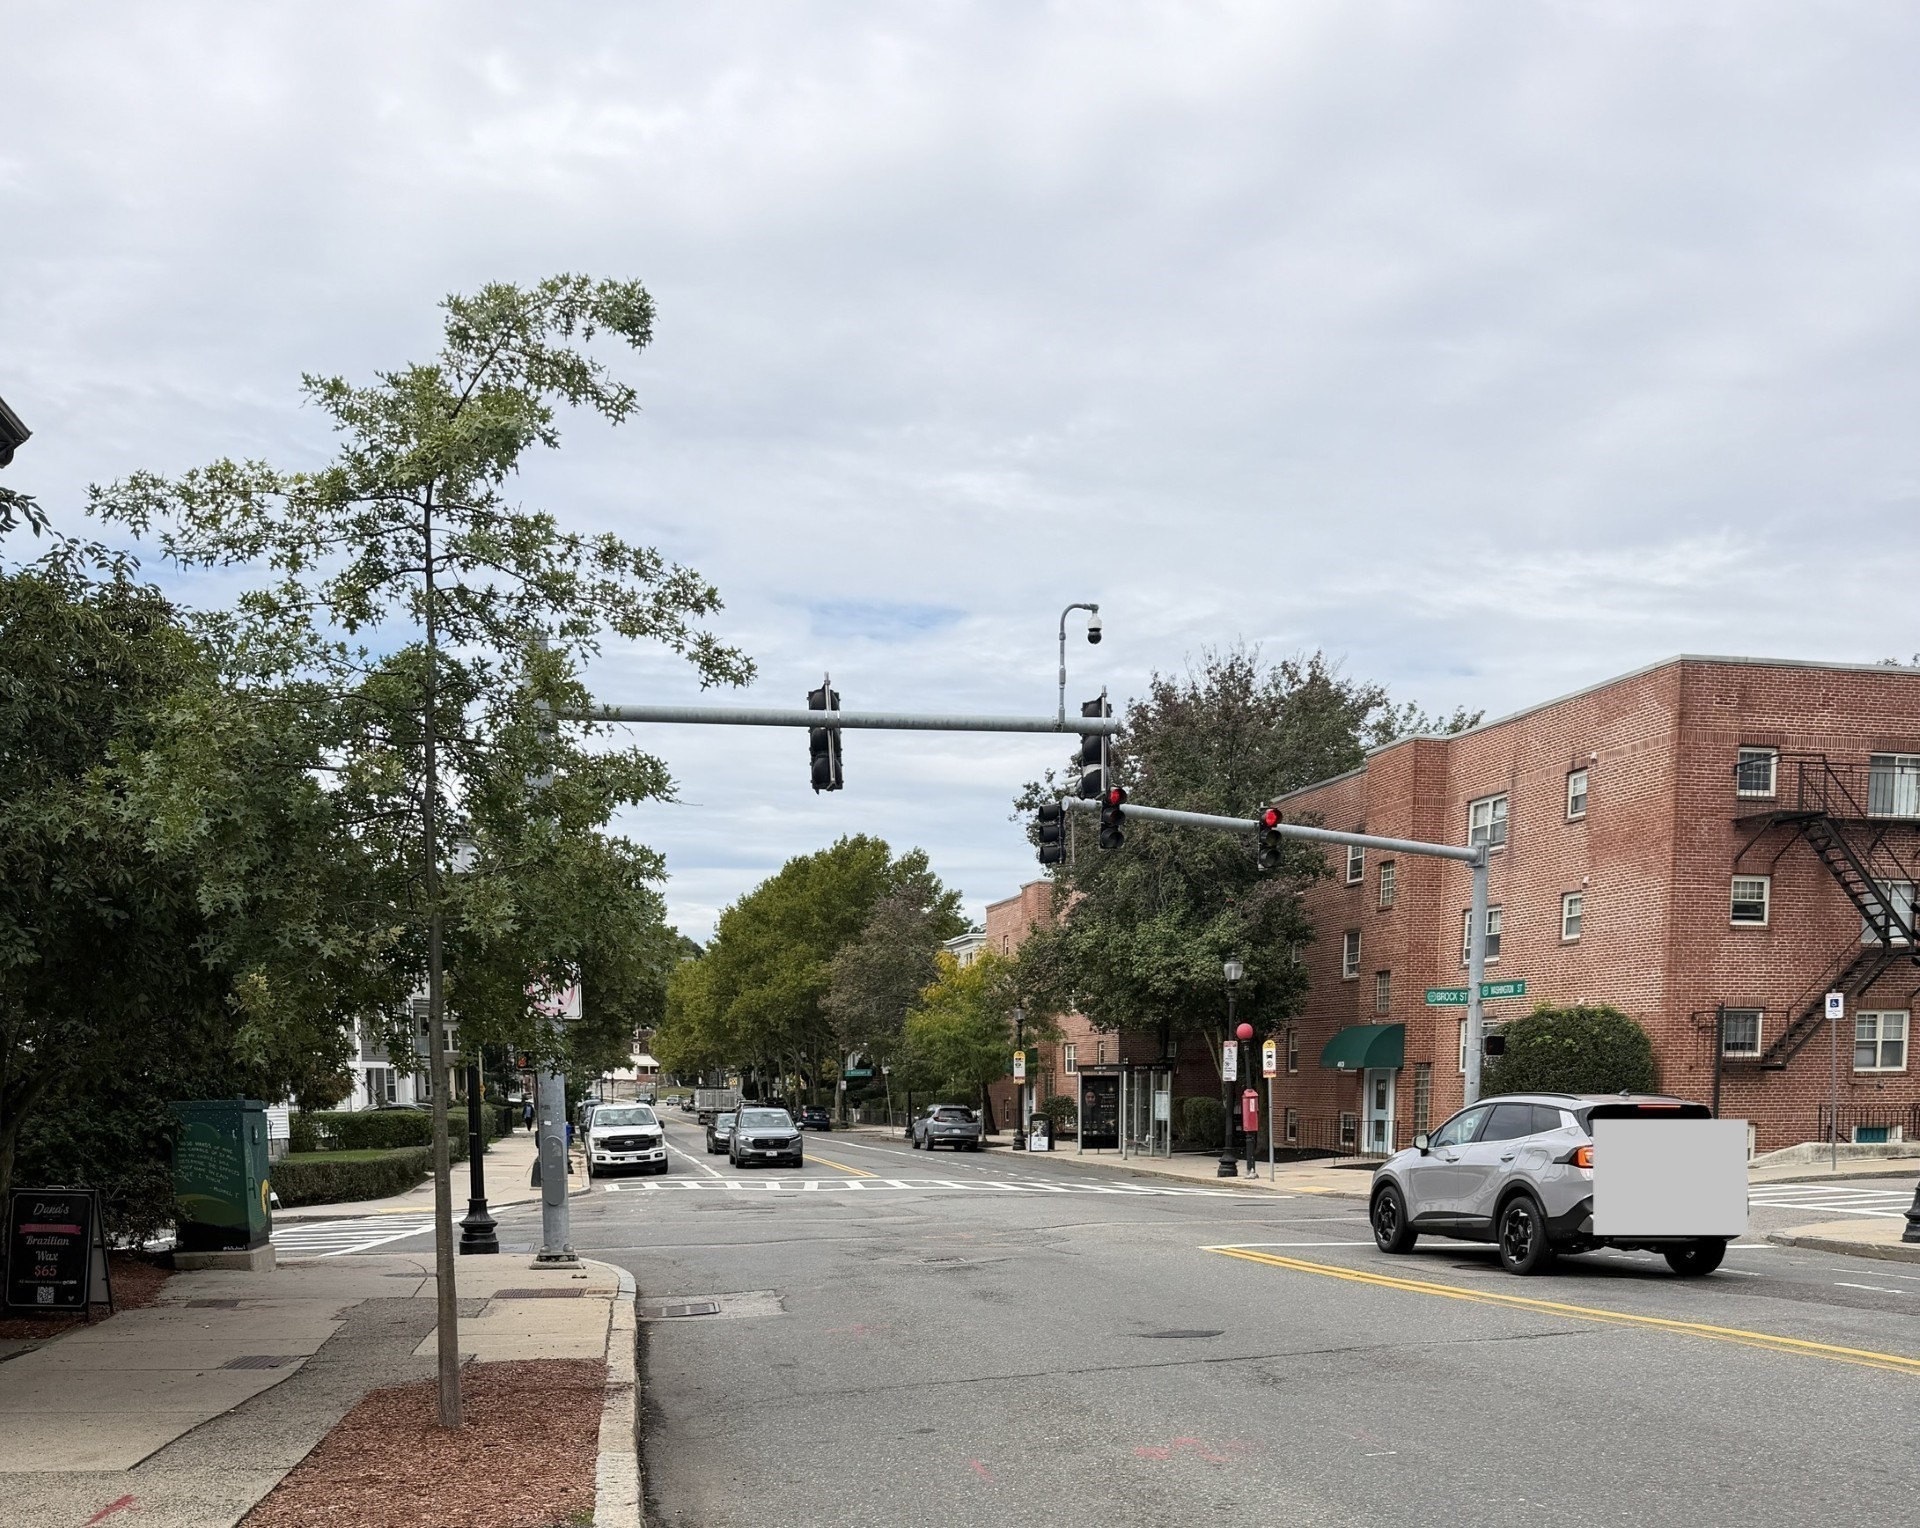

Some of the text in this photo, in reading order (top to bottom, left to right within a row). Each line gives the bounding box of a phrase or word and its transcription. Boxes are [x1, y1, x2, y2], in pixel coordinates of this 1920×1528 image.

[1490, 984, 1523, 995] WASHINGTON ST
[1436, 992, 1468, 1002] BROCK ST
[33, 1202, 70, 1216] Dana's
[25, 1235, 70, 1246] Brazilian
[35, 1250, 59, 1261] Wax
[34, 1265, 57, 1277] $65
